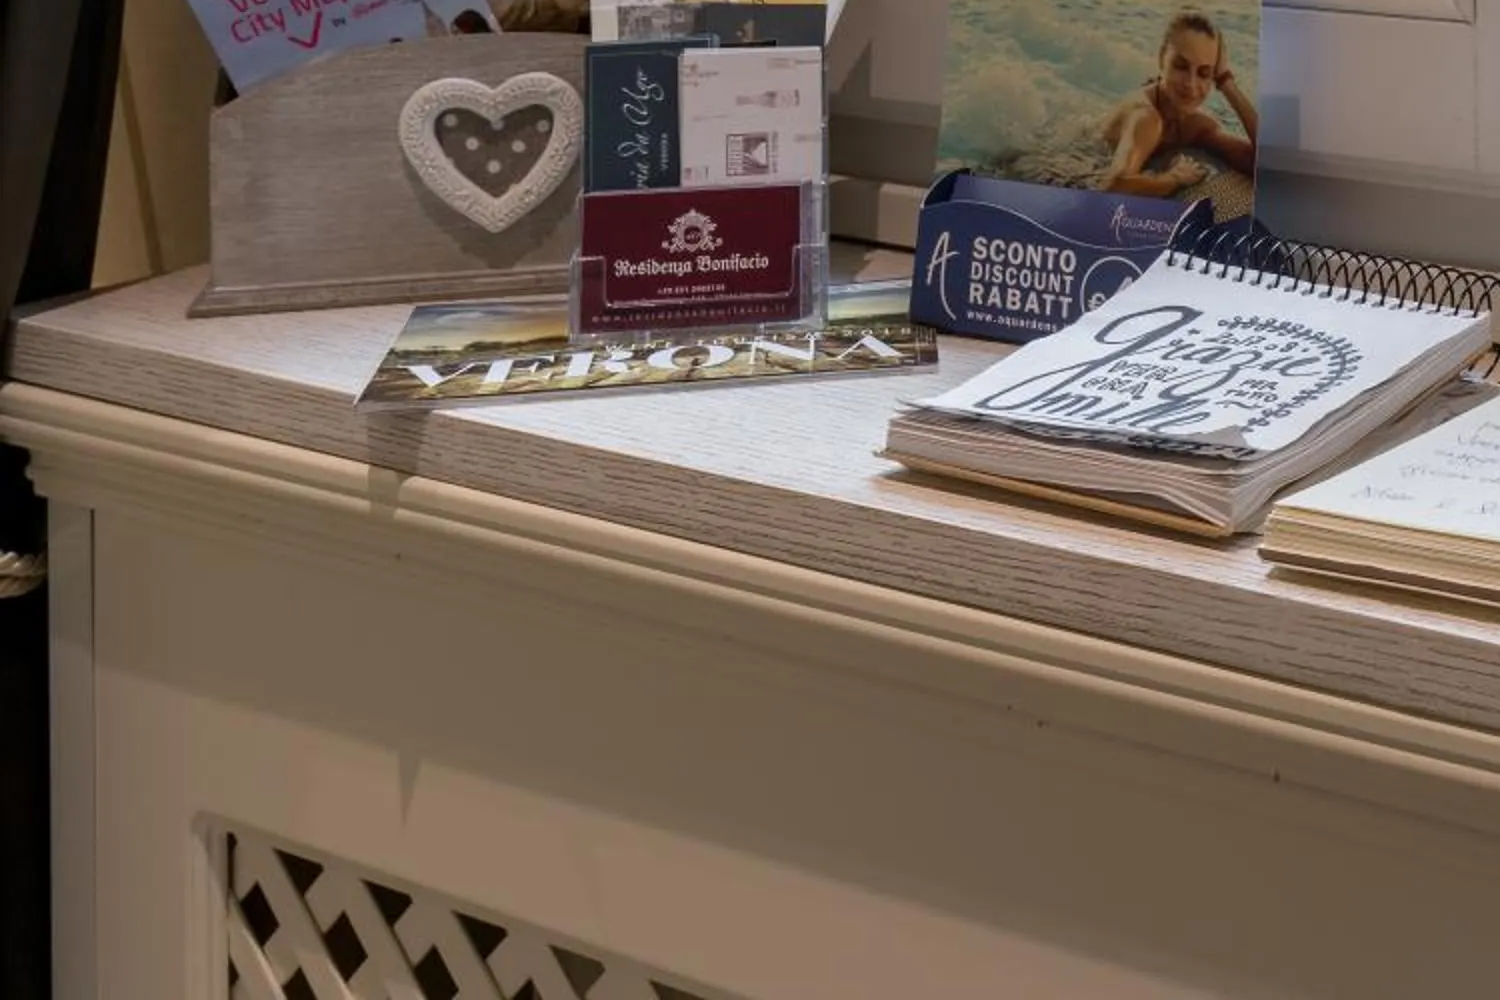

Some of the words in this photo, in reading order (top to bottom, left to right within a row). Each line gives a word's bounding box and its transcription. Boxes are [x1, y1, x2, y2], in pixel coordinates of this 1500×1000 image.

[230, 6, 286, 44] City
[612, 257, 694, 279] Residenza
[696, 251, 770, 274] Bonifacio
[971, 234, 1078, 274] SCONTO
[969, 261, 1075, 296] DISCOUNT
[967, 281, 1074, 320] RABATT
[401, 333, 914, 388] VERONA
